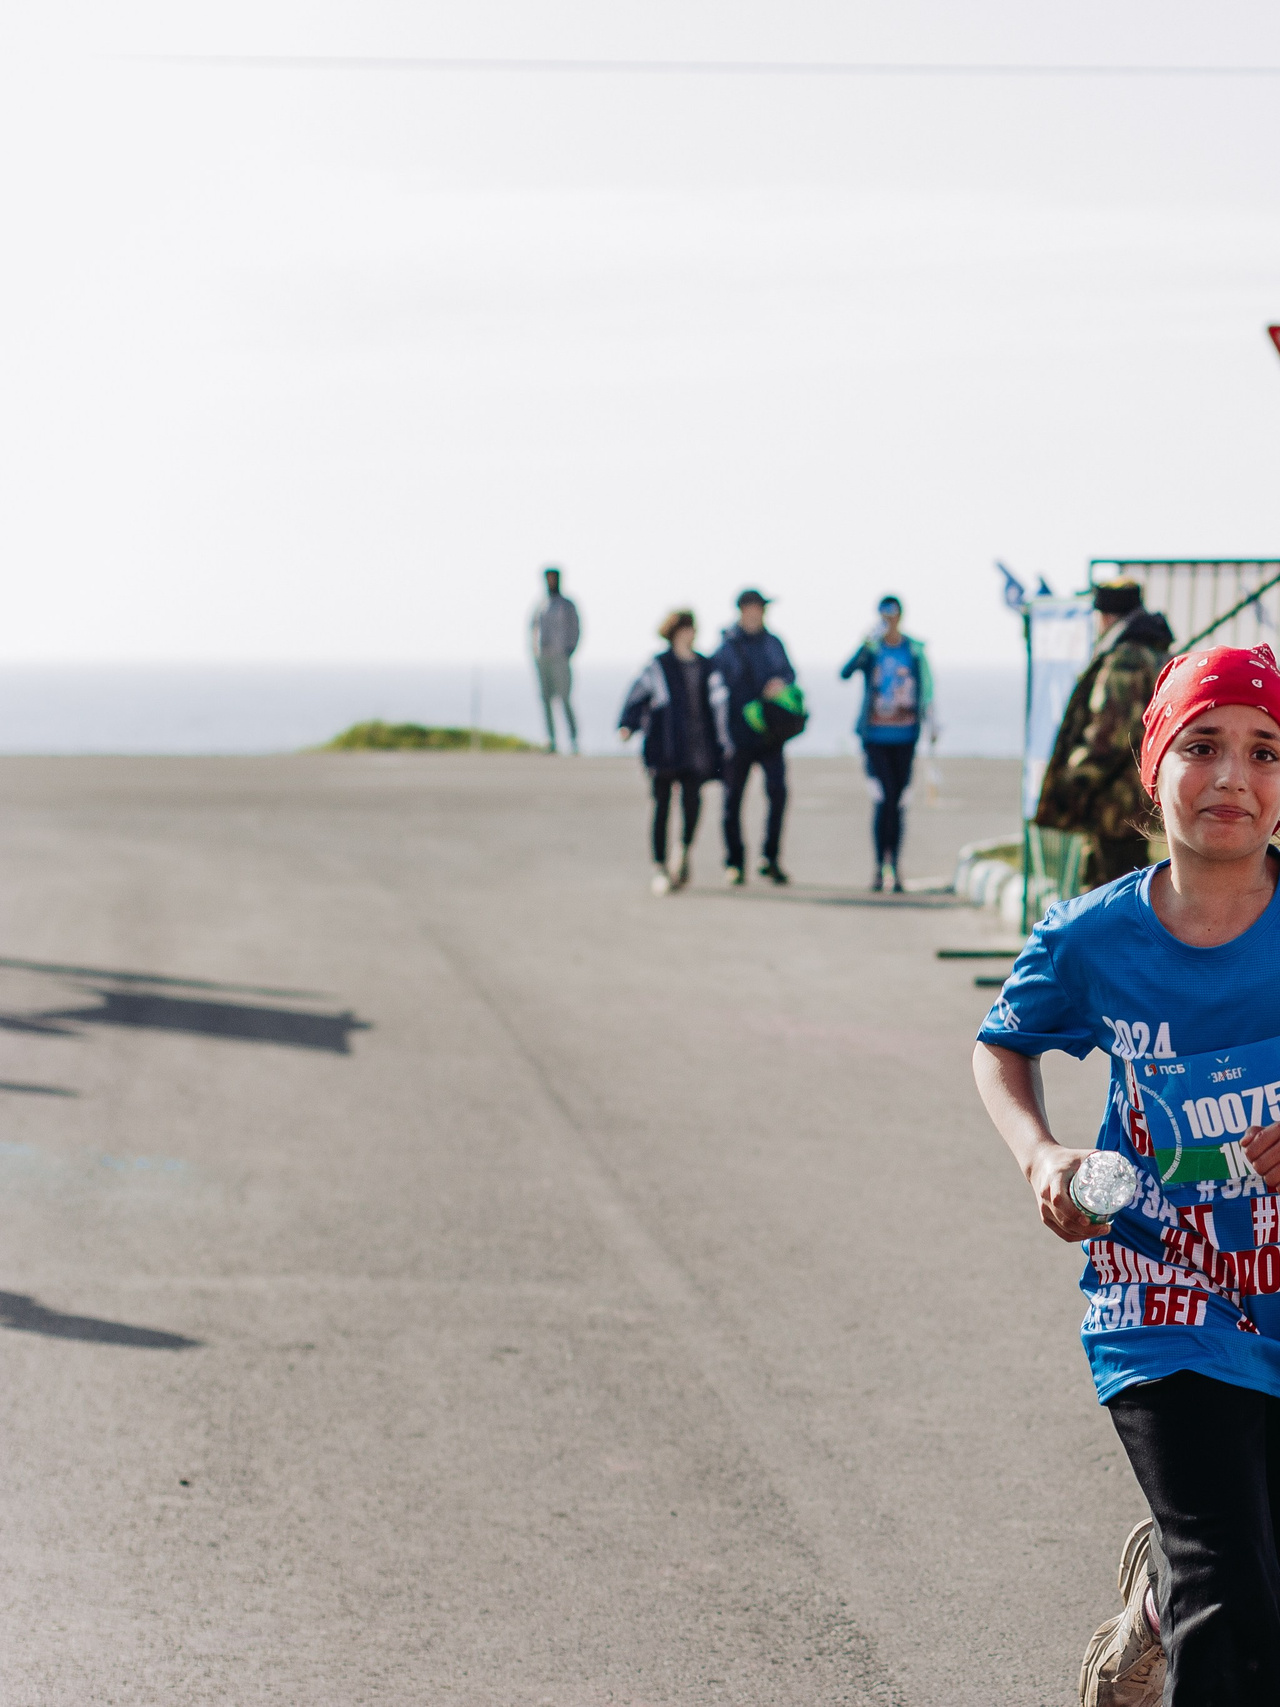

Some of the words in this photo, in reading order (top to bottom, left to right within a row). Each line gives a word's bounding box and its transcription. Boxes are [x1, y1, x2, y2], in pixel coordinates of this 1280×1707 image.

[1102, 1015, 1177, 1060] 2024
[1159, 1063, 1186, 1076] ПСБ
[1089, 1284, 1209, 1332] #ЗАБЕГ
